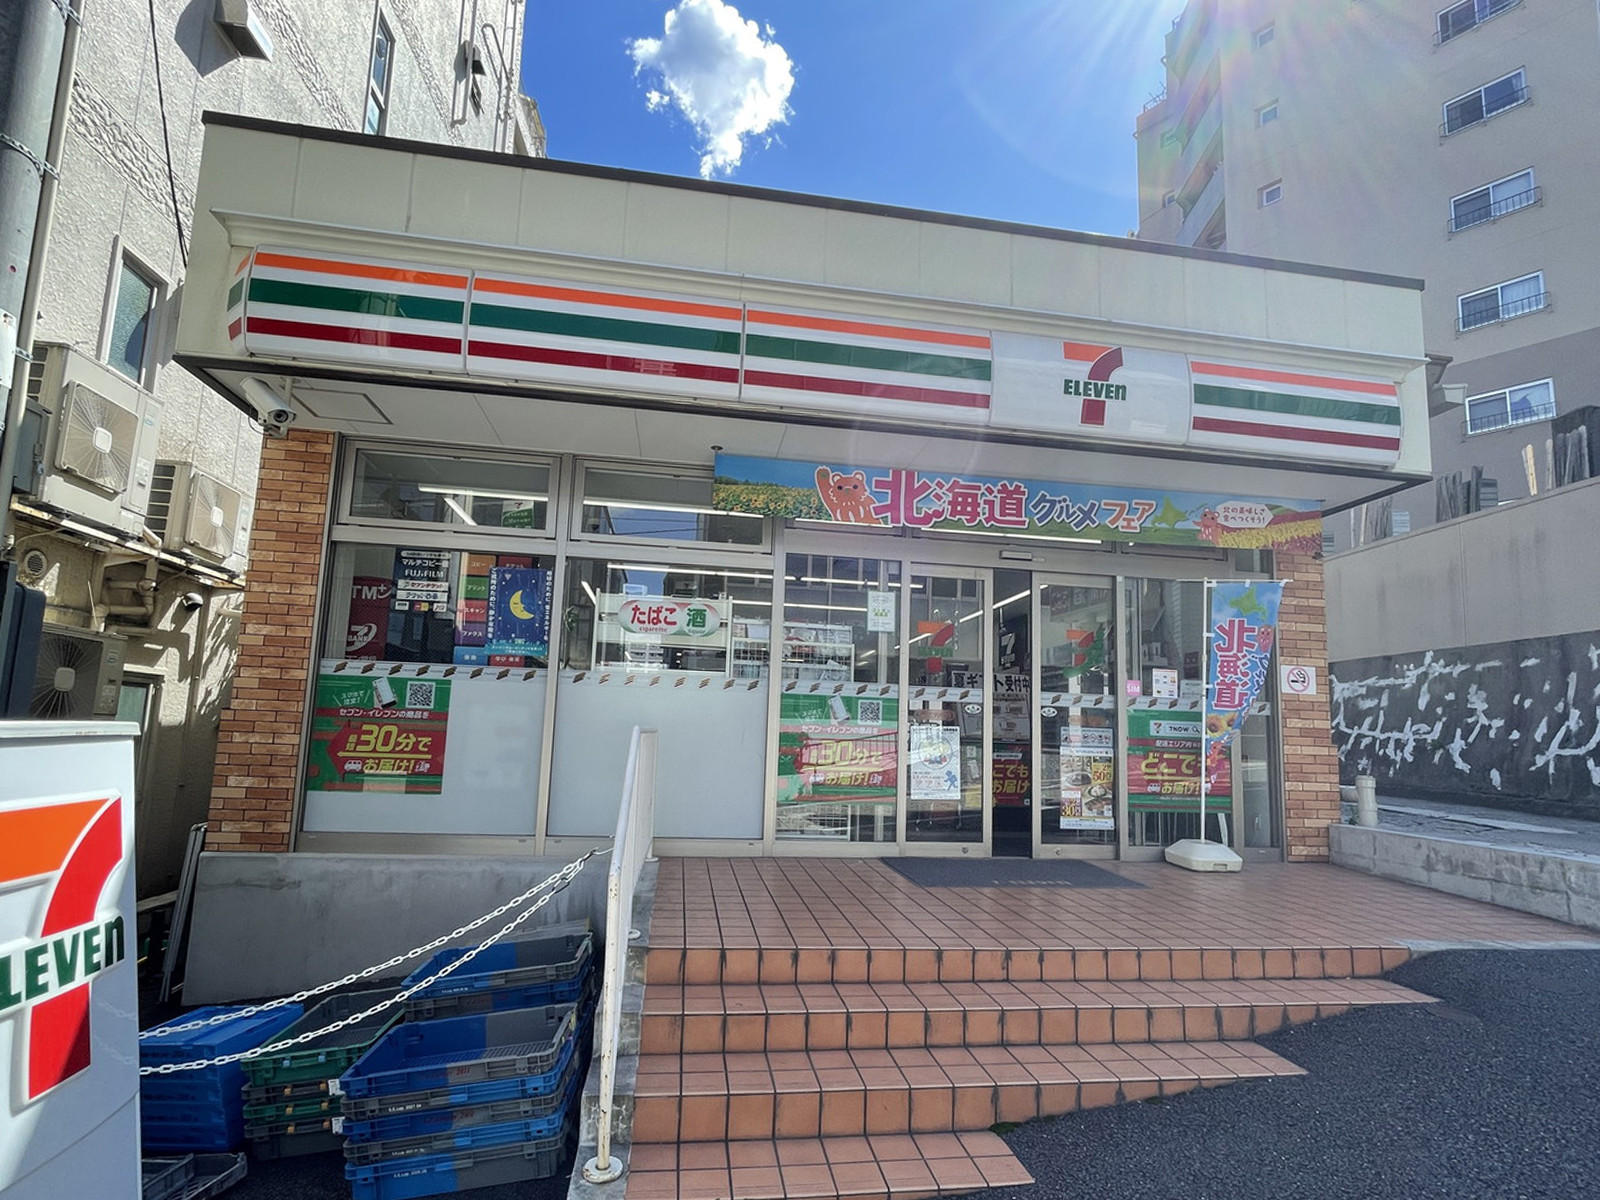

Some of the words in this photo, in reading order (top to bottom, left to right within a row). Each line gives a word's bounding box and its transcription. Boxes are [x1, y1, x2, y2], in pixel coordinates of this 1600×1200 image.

[631, 605, 677, 626] たばこ
[686, 608, 707, 628] 酒
